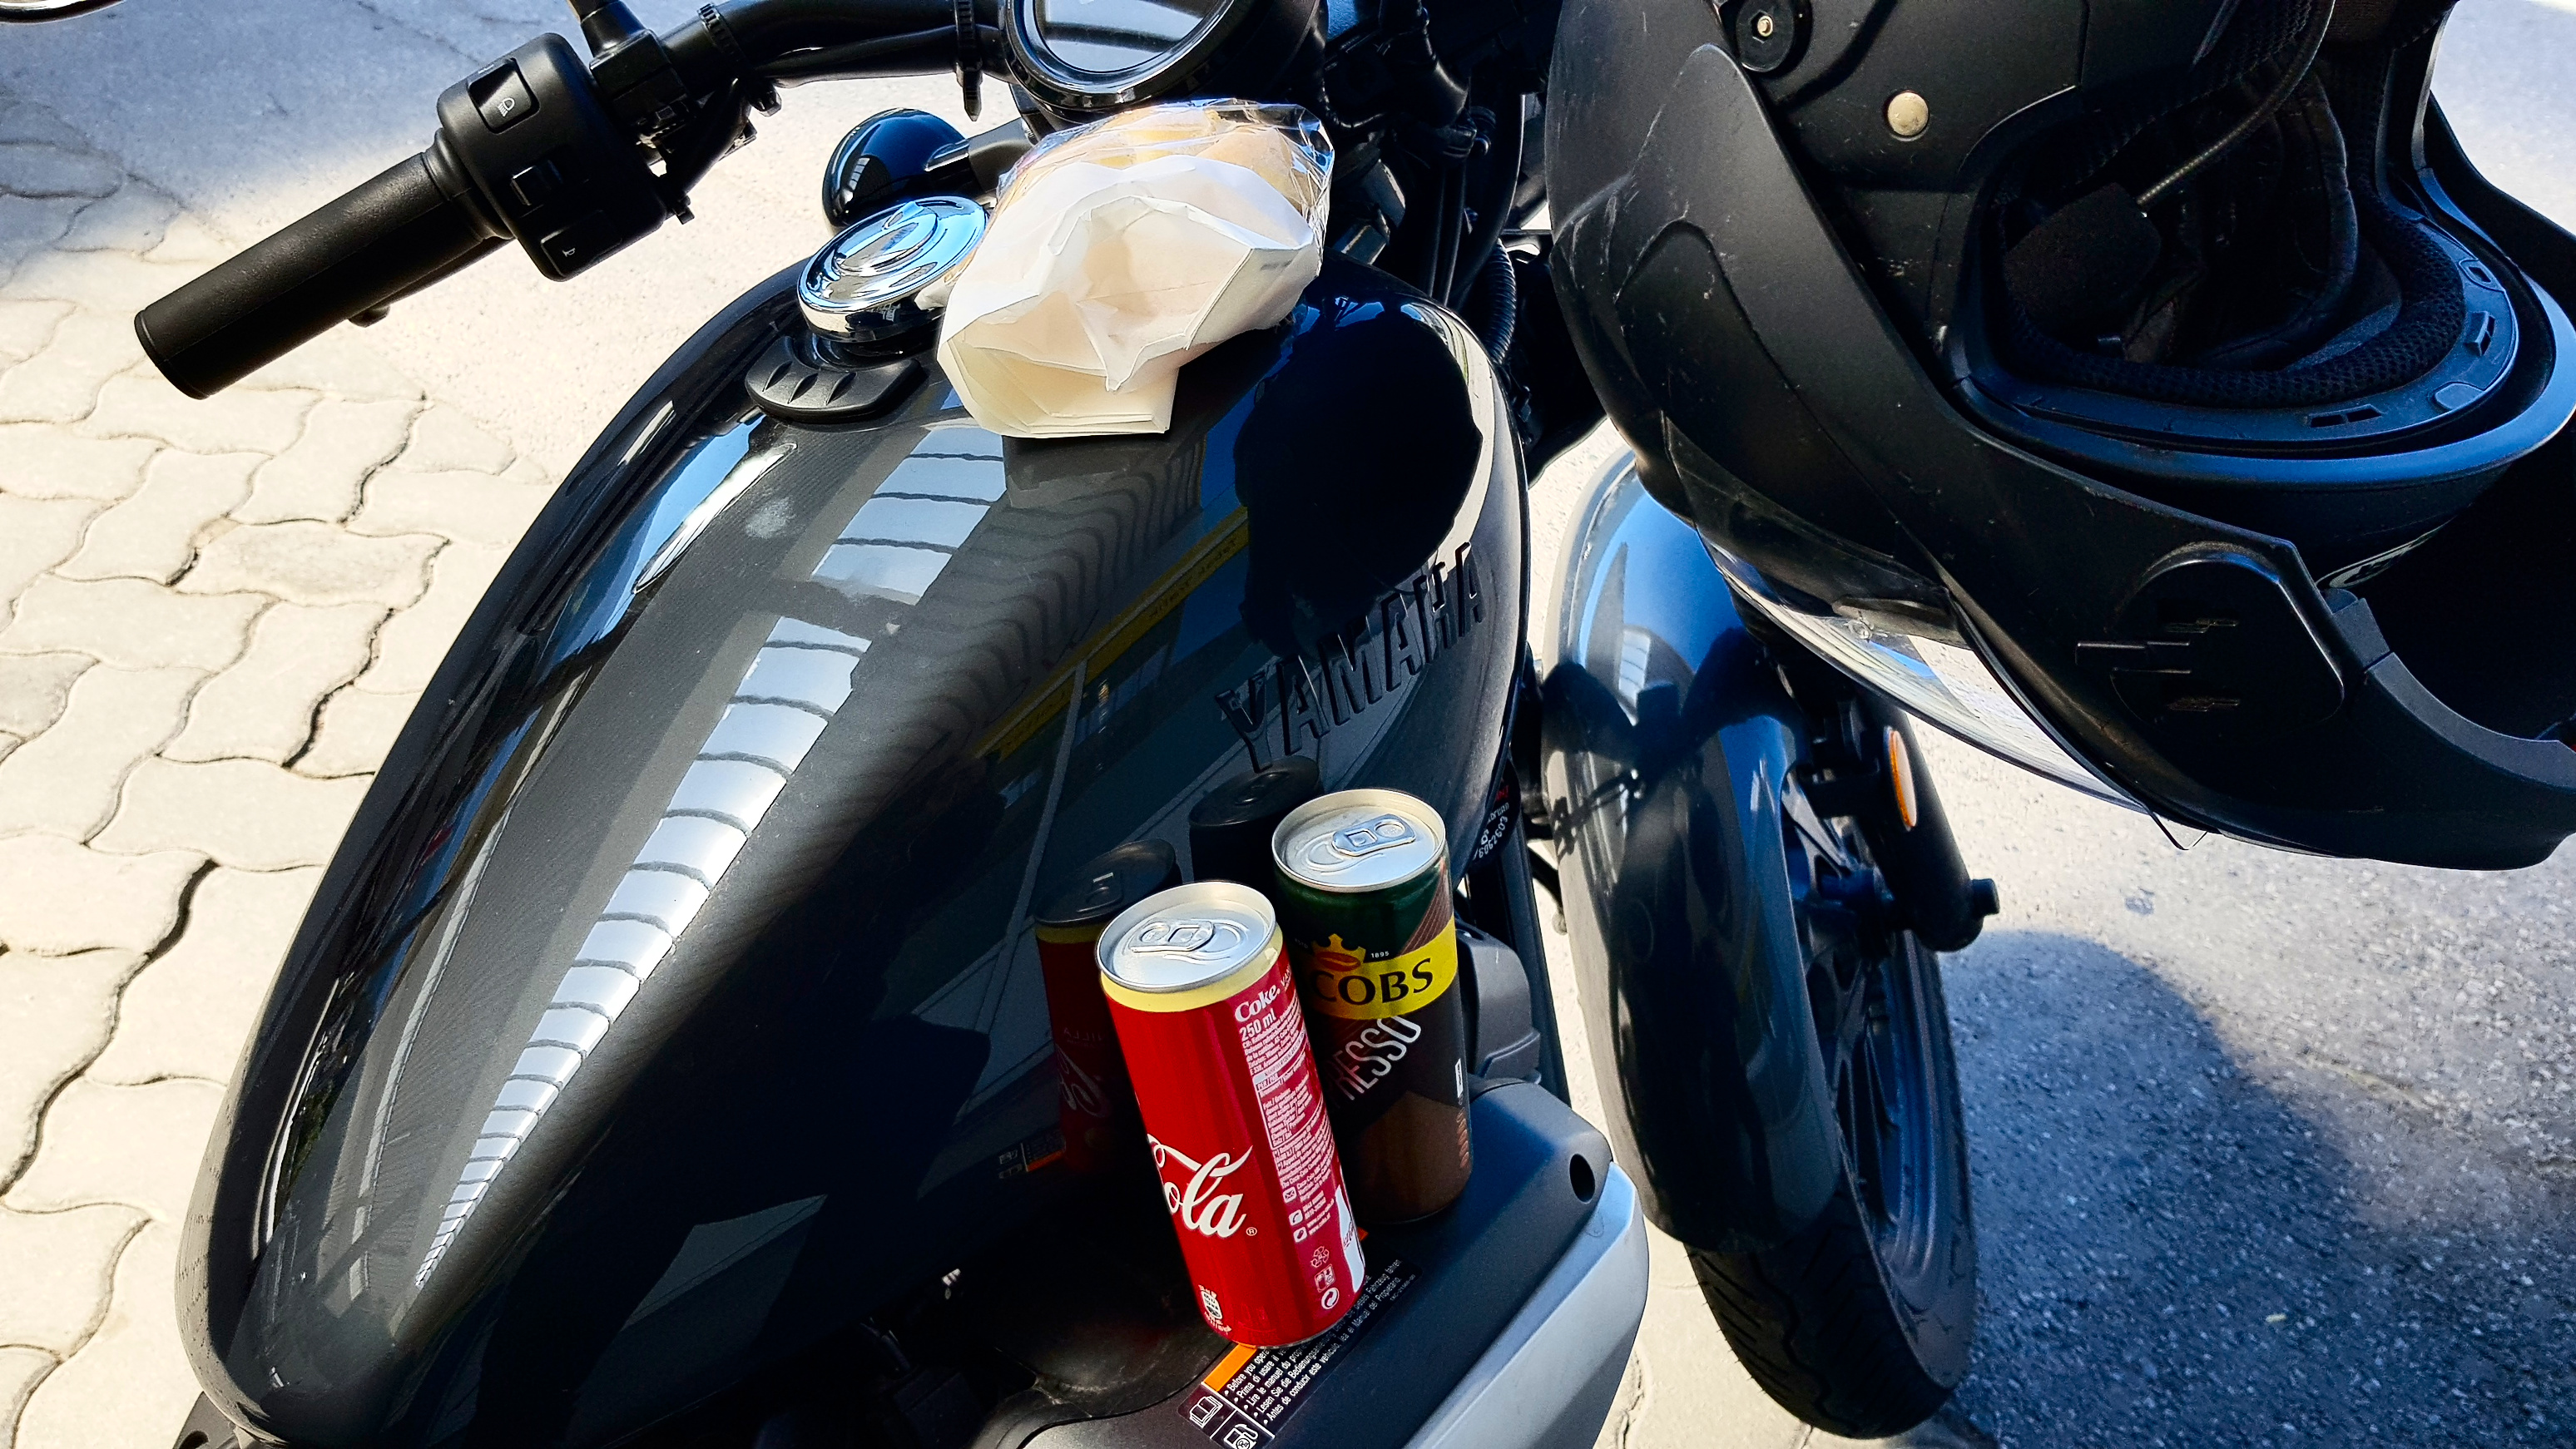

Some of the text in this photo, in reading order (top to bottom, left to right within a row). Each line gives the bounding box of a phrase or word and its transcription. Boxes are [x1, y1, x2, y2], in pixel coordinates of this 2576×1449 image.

[1216, 542, 1486, 773] YAMAHA
[1310, 957, 1433, 1007] COBS
[1240, 1008, 1277, 1040] 250 ml
[1323, 1014, 1422, 1102] RESSO
[1147, 1133, 1254, 1239] ola
[1226, 1371, 1246, 1392] Before
[1243, 1362, 1257, 1377] you
[1253, 1346, 1272, 1366] opera
[1236, 1353, 1279, 1399] Prima di usare il
[1256, 1394, 1275, 1414] Lesen
[1271, 1384, 1284, 1397] Sie
[1280, 1375, 1292, 1388] die
[1365, 1270, 1390, 1296] Fahrzeug
[1266, 1402, 1285, 1422] Antes
[1280, 1393, 1291, 1405] de
[1287, 1372, 1310, 1397] conducir
[1308, 1361, 1322, 1376] este
[1337, 1330, 1350, 1343] lea
[1345, 1323, 1355, 1334] el
[1350, 1307, 1371, 1328] Manual
[1366, 1298, 1379, 1310] del
[1246, 1392, 1261, 1407] Lire
[1256, 1384, 1266, 1395] le
[1263, 1367, 1284, 1388] manuel
[1280, 1358, 1291, 1370] du
